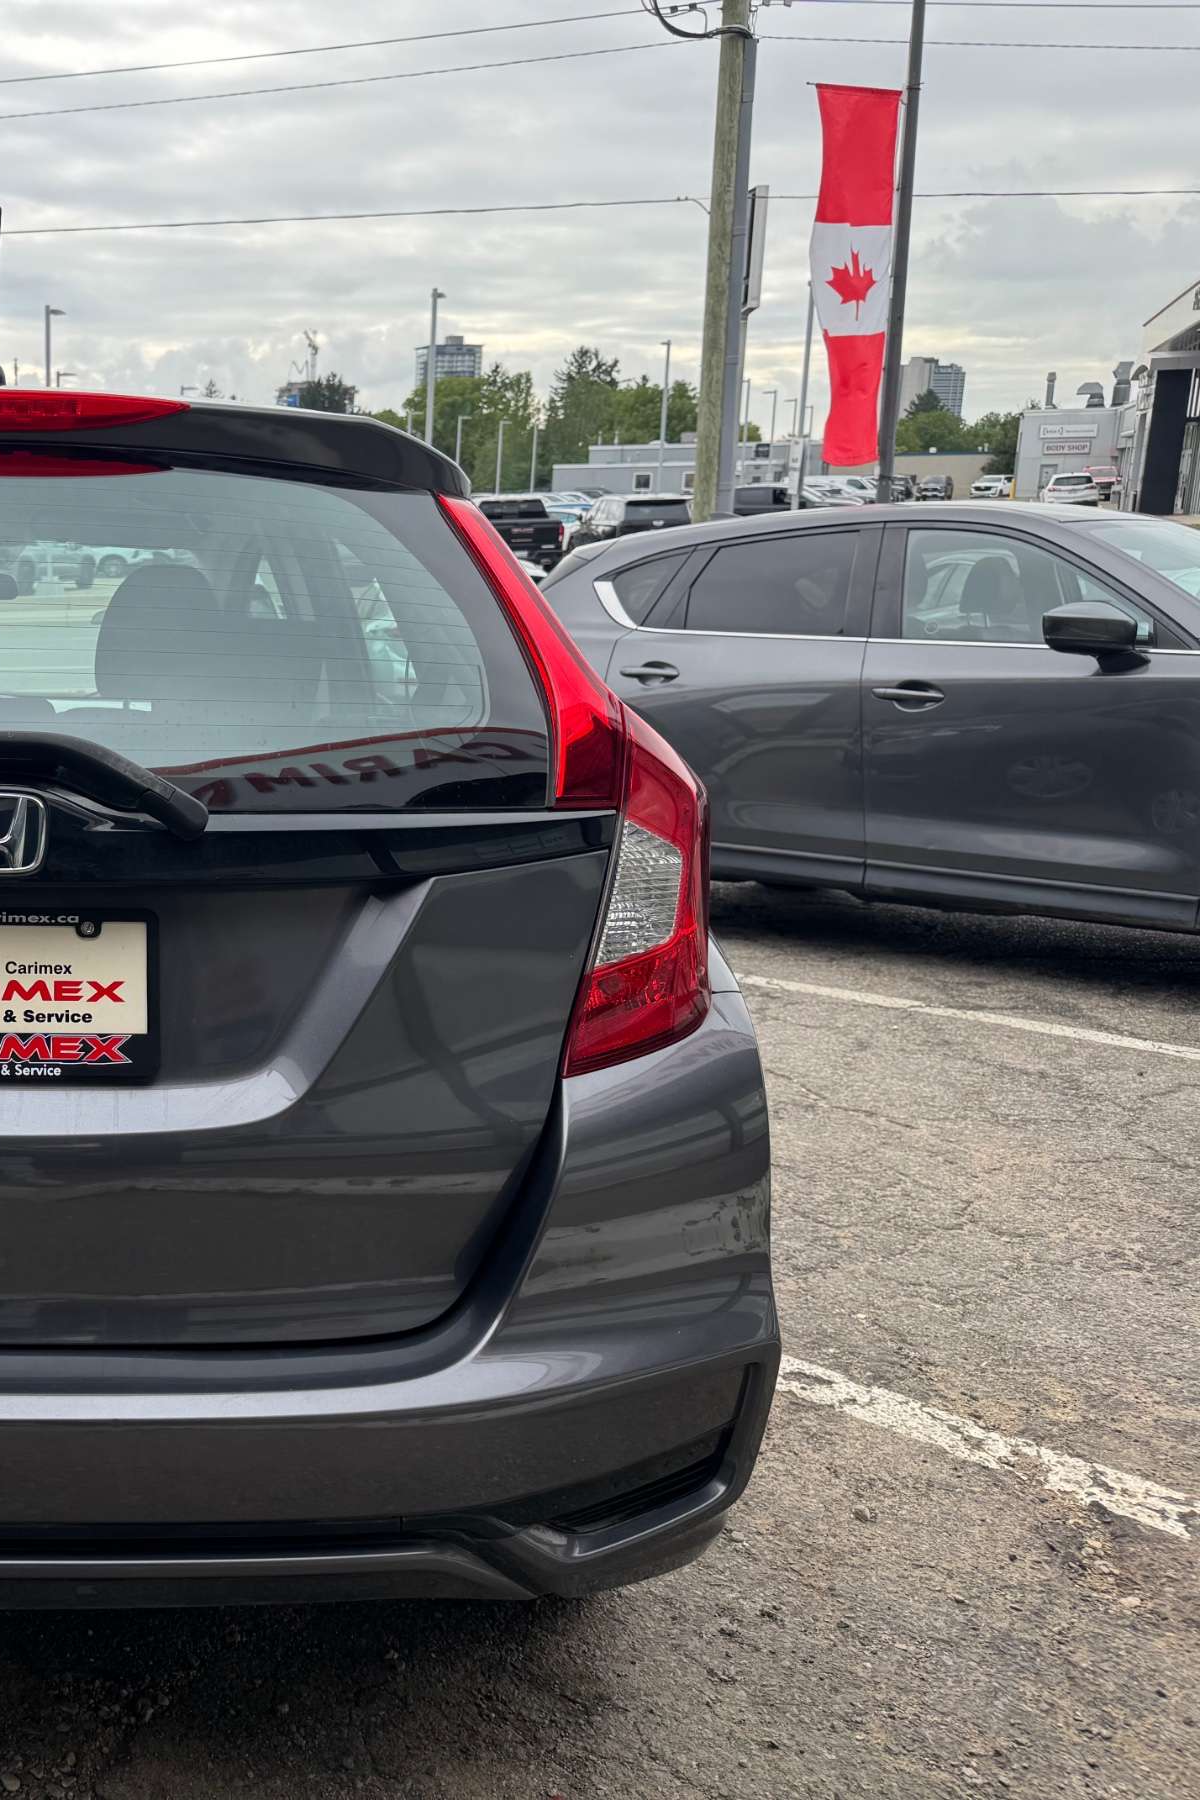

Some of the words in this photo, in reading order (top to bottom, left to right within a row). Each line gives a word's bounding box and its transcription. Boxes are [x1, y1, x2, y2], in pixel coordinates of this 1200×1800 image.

[5, 960, 73, 975] Carimex
[3, 1009, 17, 1023] &
[23, 1009, 93, 1024] Service
[1, 1064, 11, 1076] &
[14, 1063, 62, 1077] Service
